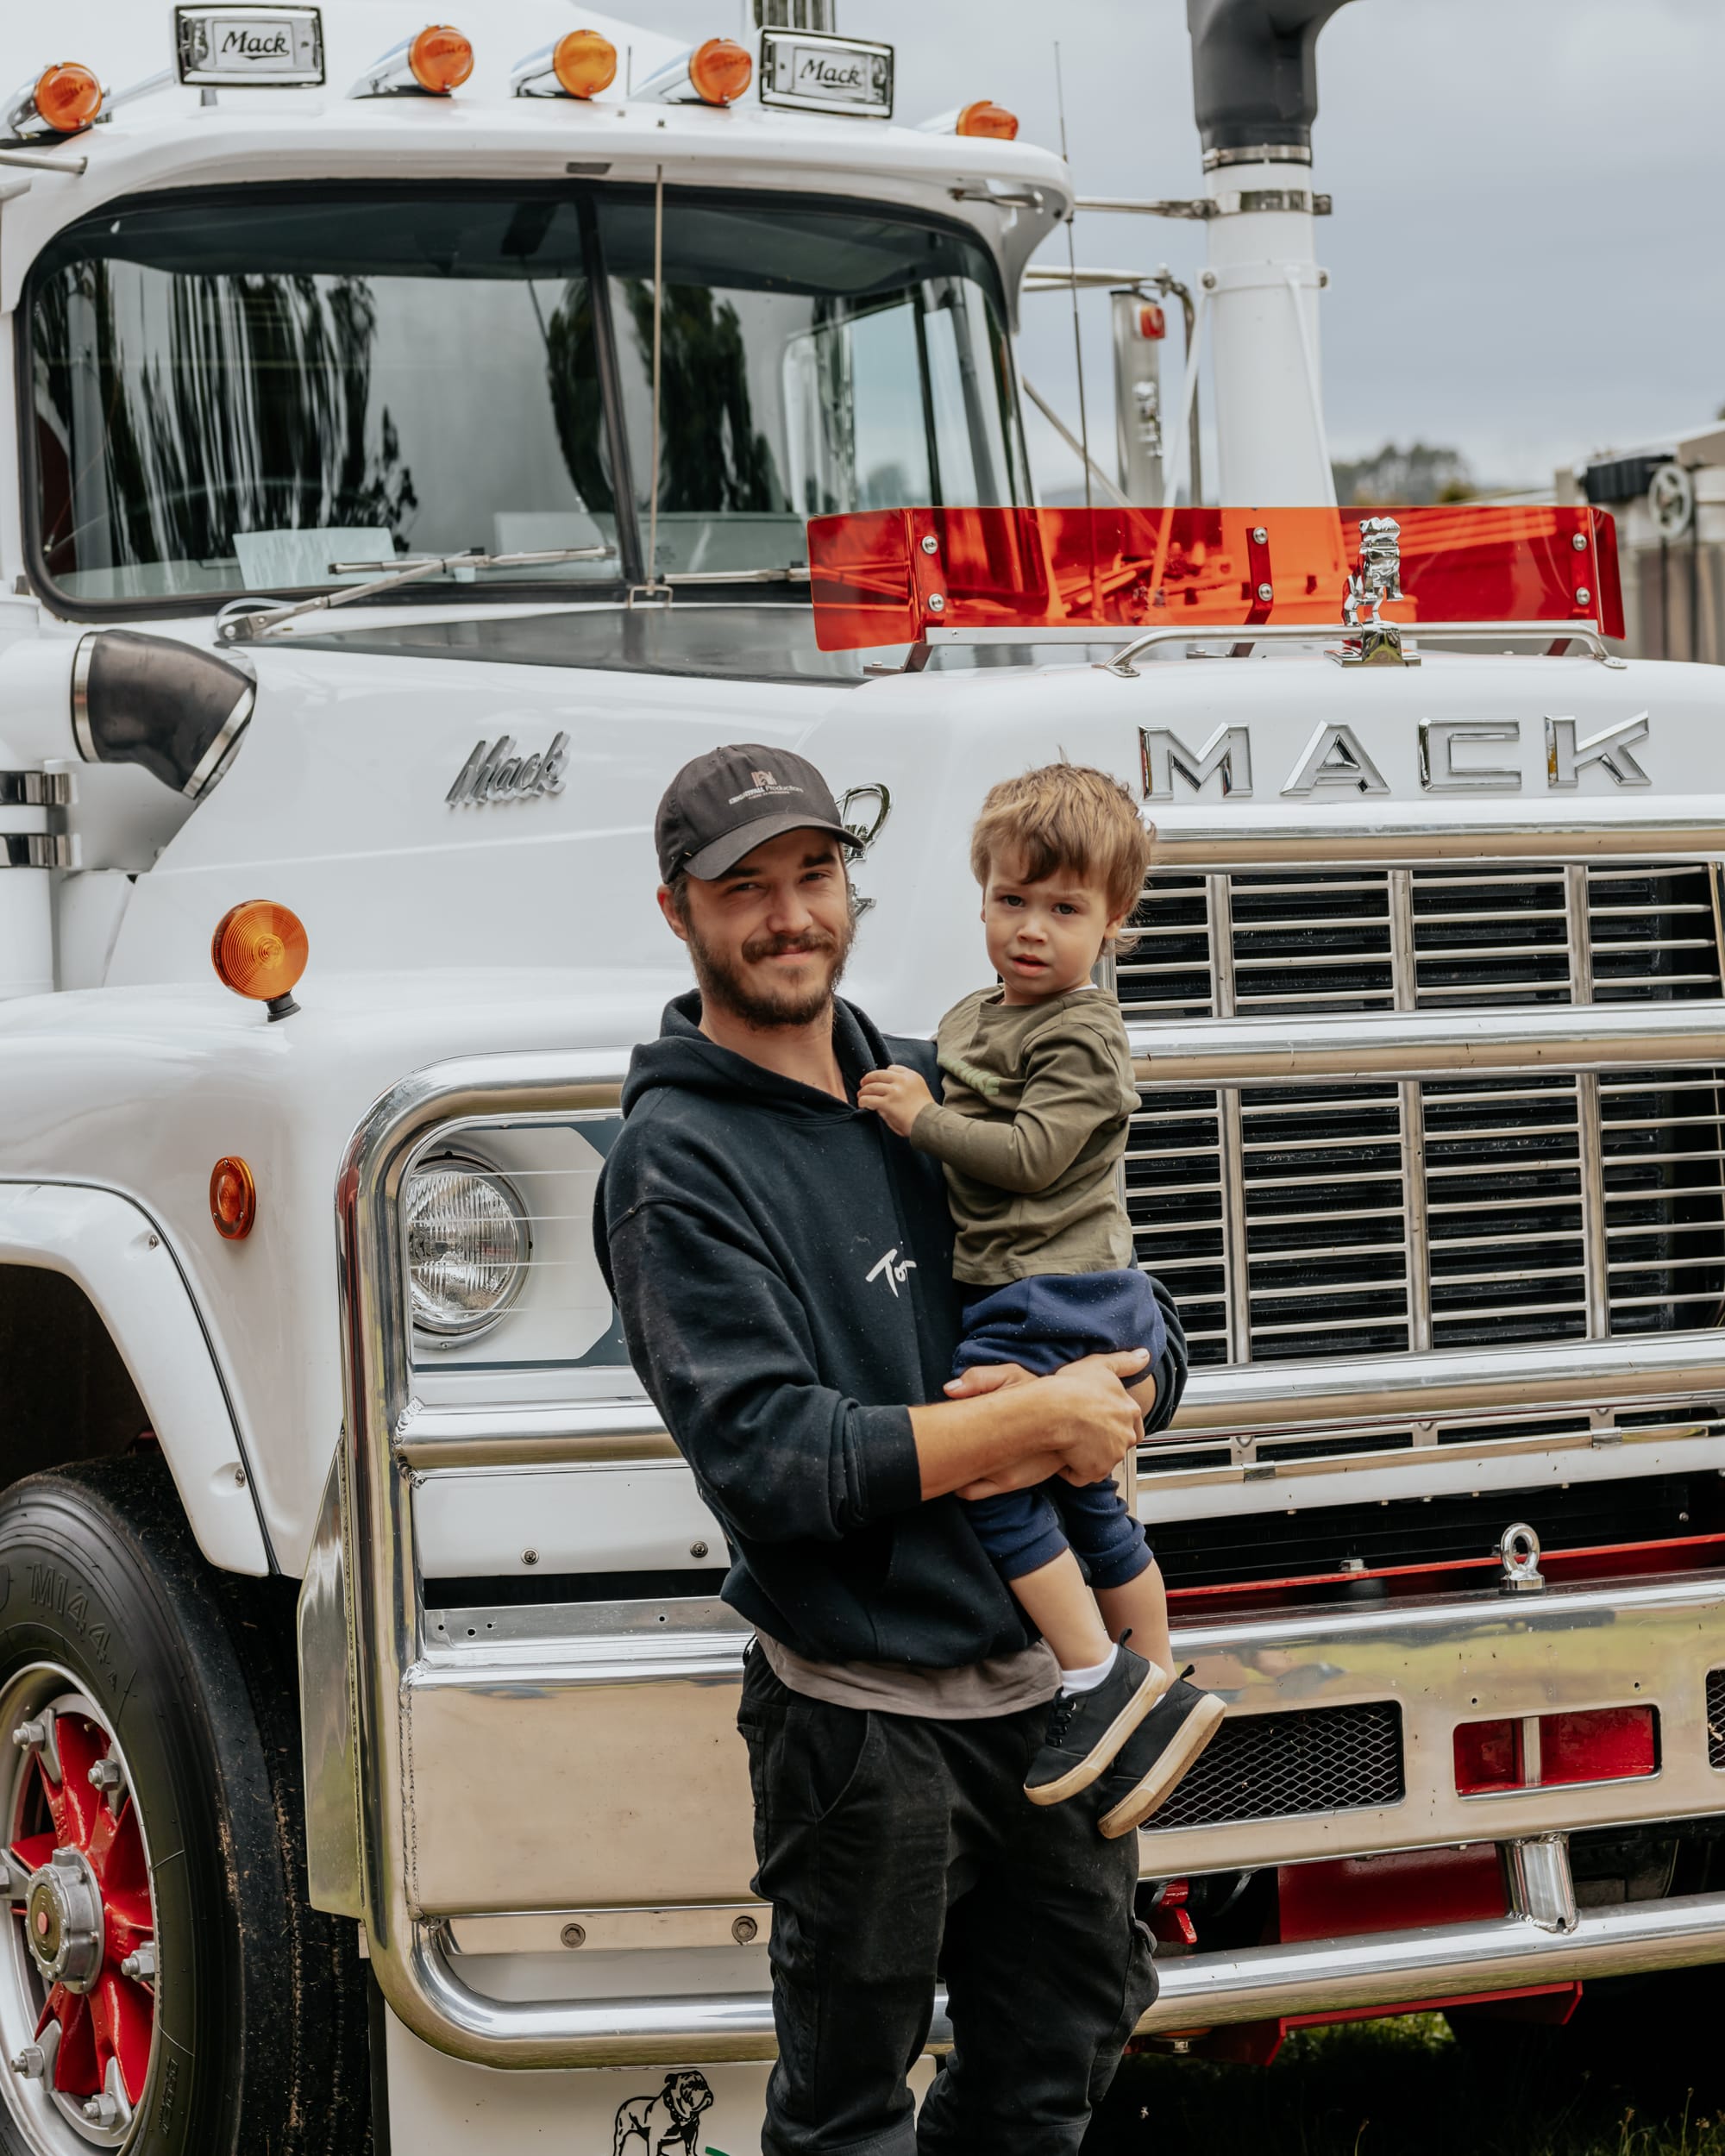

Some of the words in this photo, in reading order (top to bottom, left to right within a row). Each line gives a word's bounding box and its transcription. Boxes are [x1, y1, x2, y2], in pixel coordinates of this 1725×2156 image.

[221, 30, 290, 60] Mack
[800, 58, 862, 89] Mack
[444, 731, 569, 806] Mack
[1138, 711, 1652, 800] MACK
[31, 1561, 112, 1665] M144
